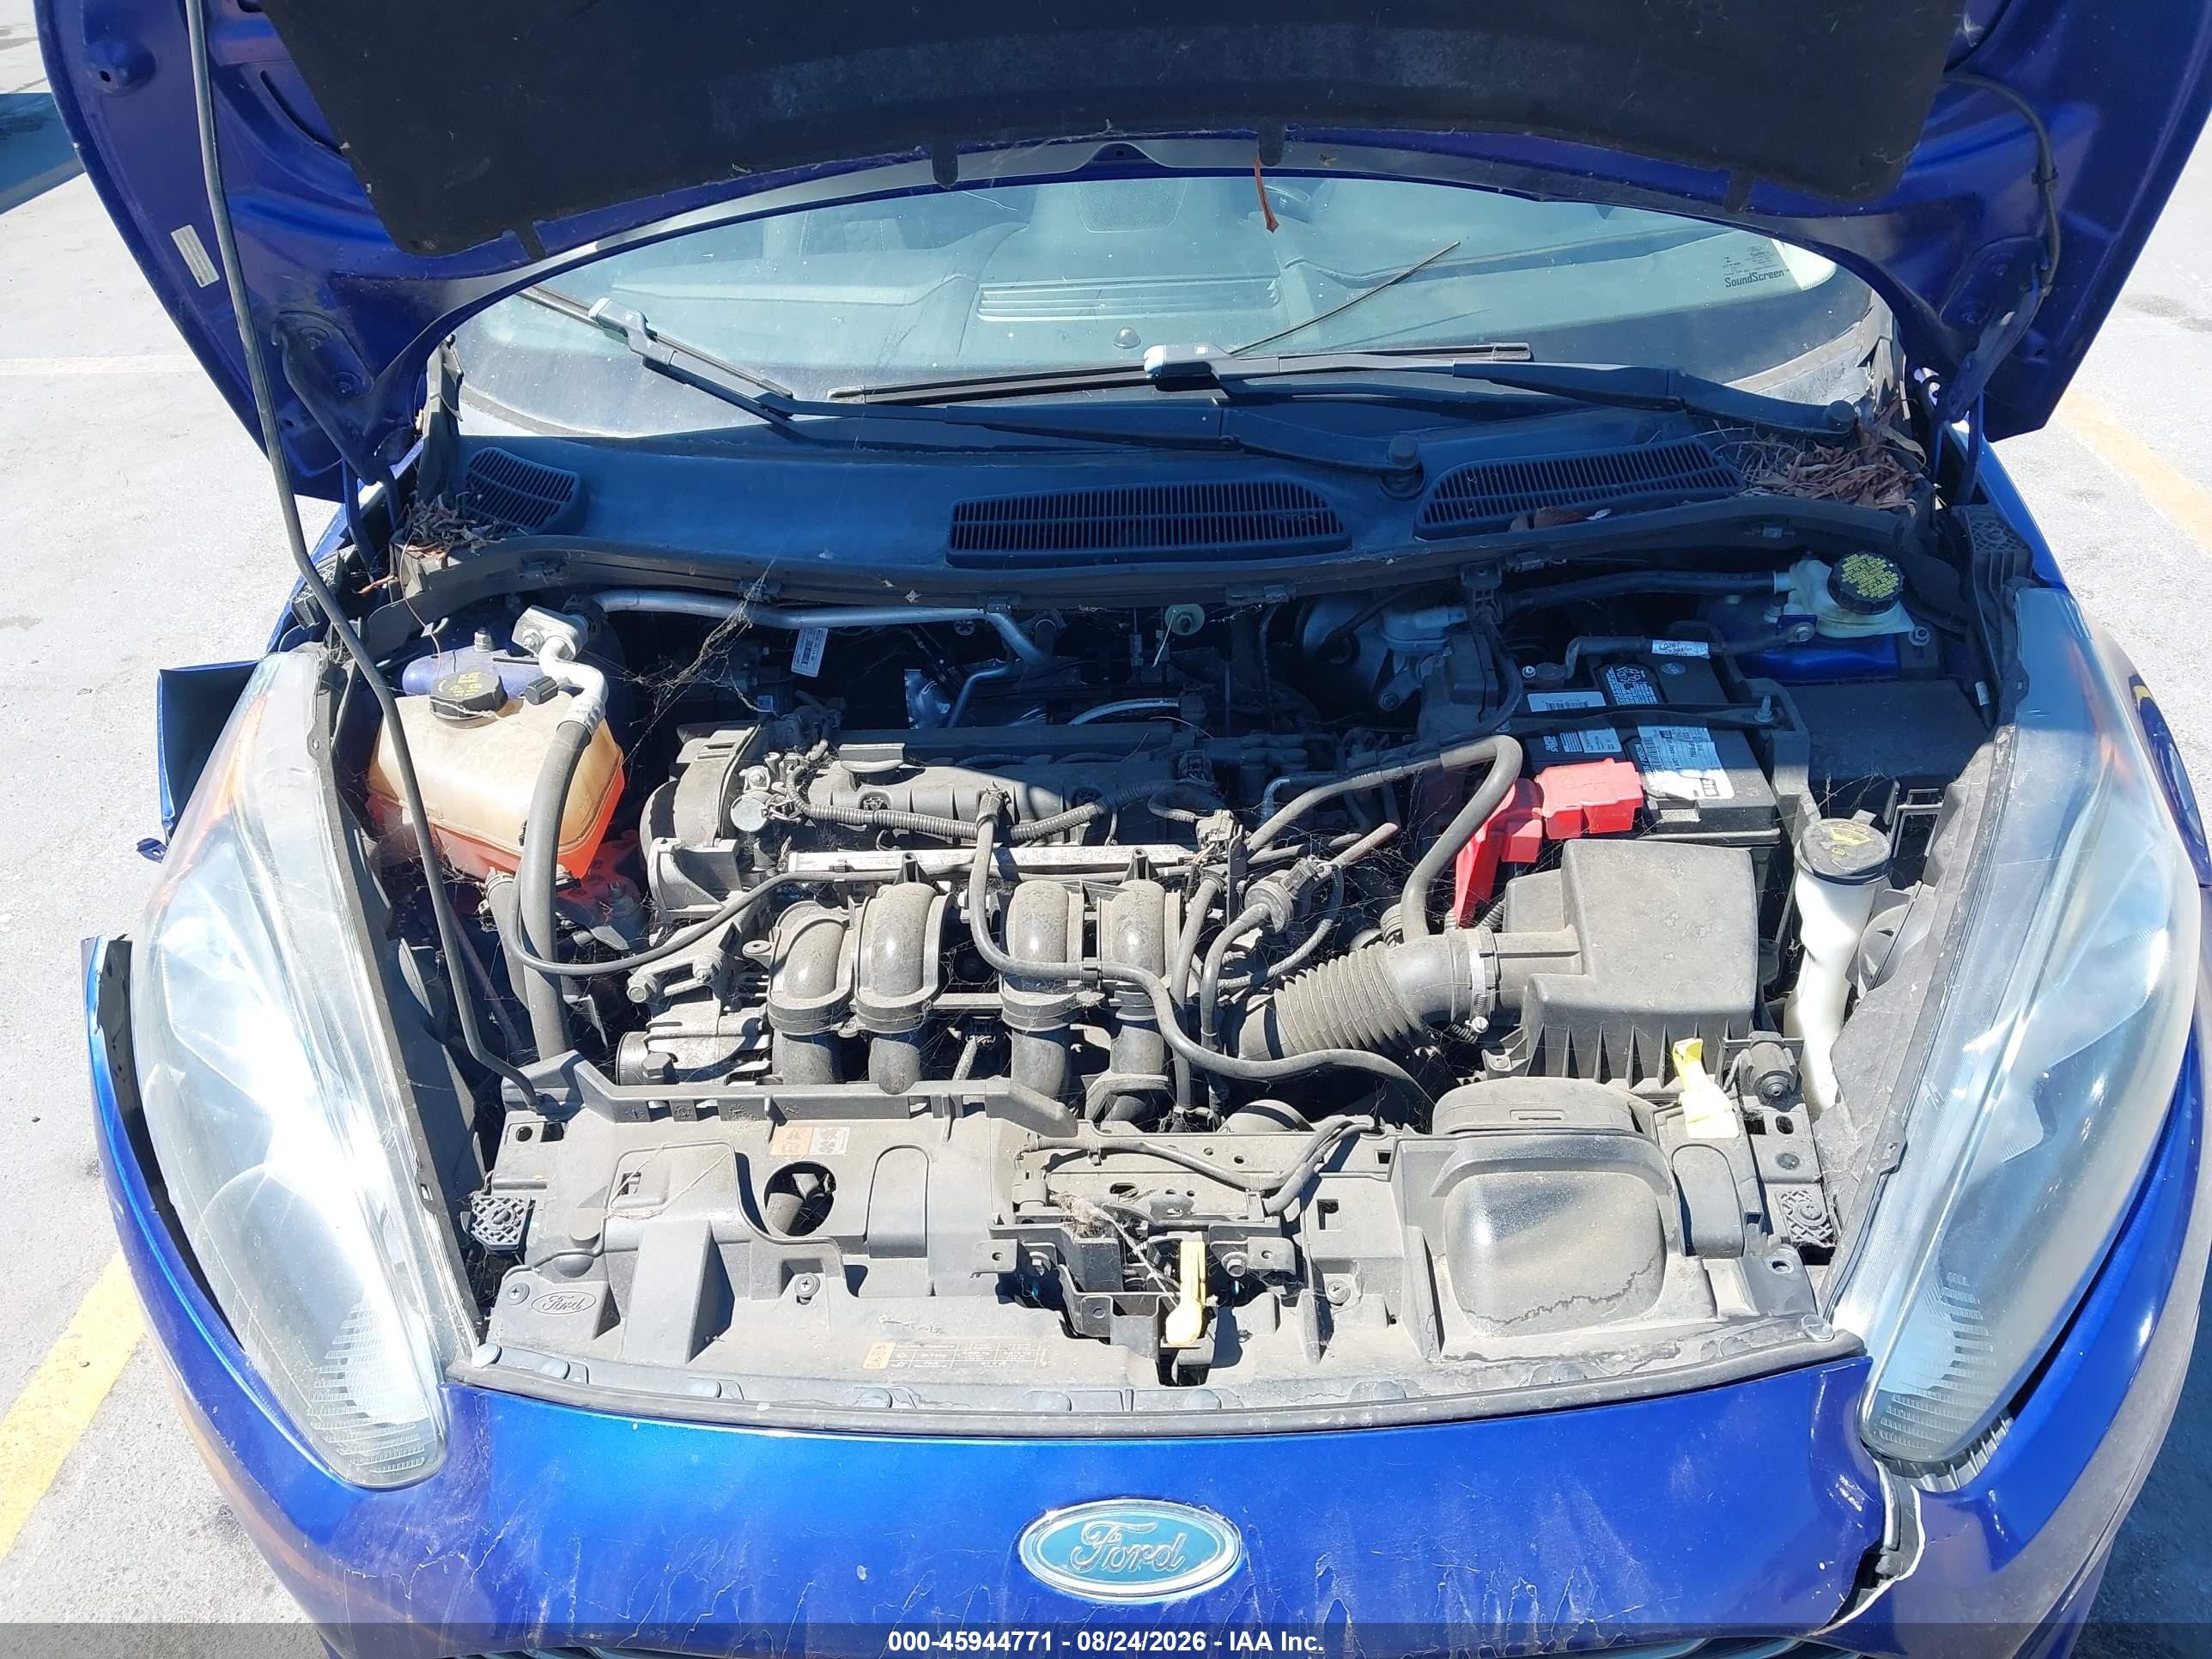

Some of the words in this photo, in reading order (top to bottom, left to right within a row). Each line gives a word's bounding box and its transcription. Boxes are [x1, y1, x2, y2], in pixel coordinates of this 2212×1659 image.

[1725, 270, 1784, 288] SoundScreen
[542, 1295, 586, 1311] Ford
[1069, 1520, 1189, 1572] Ford
